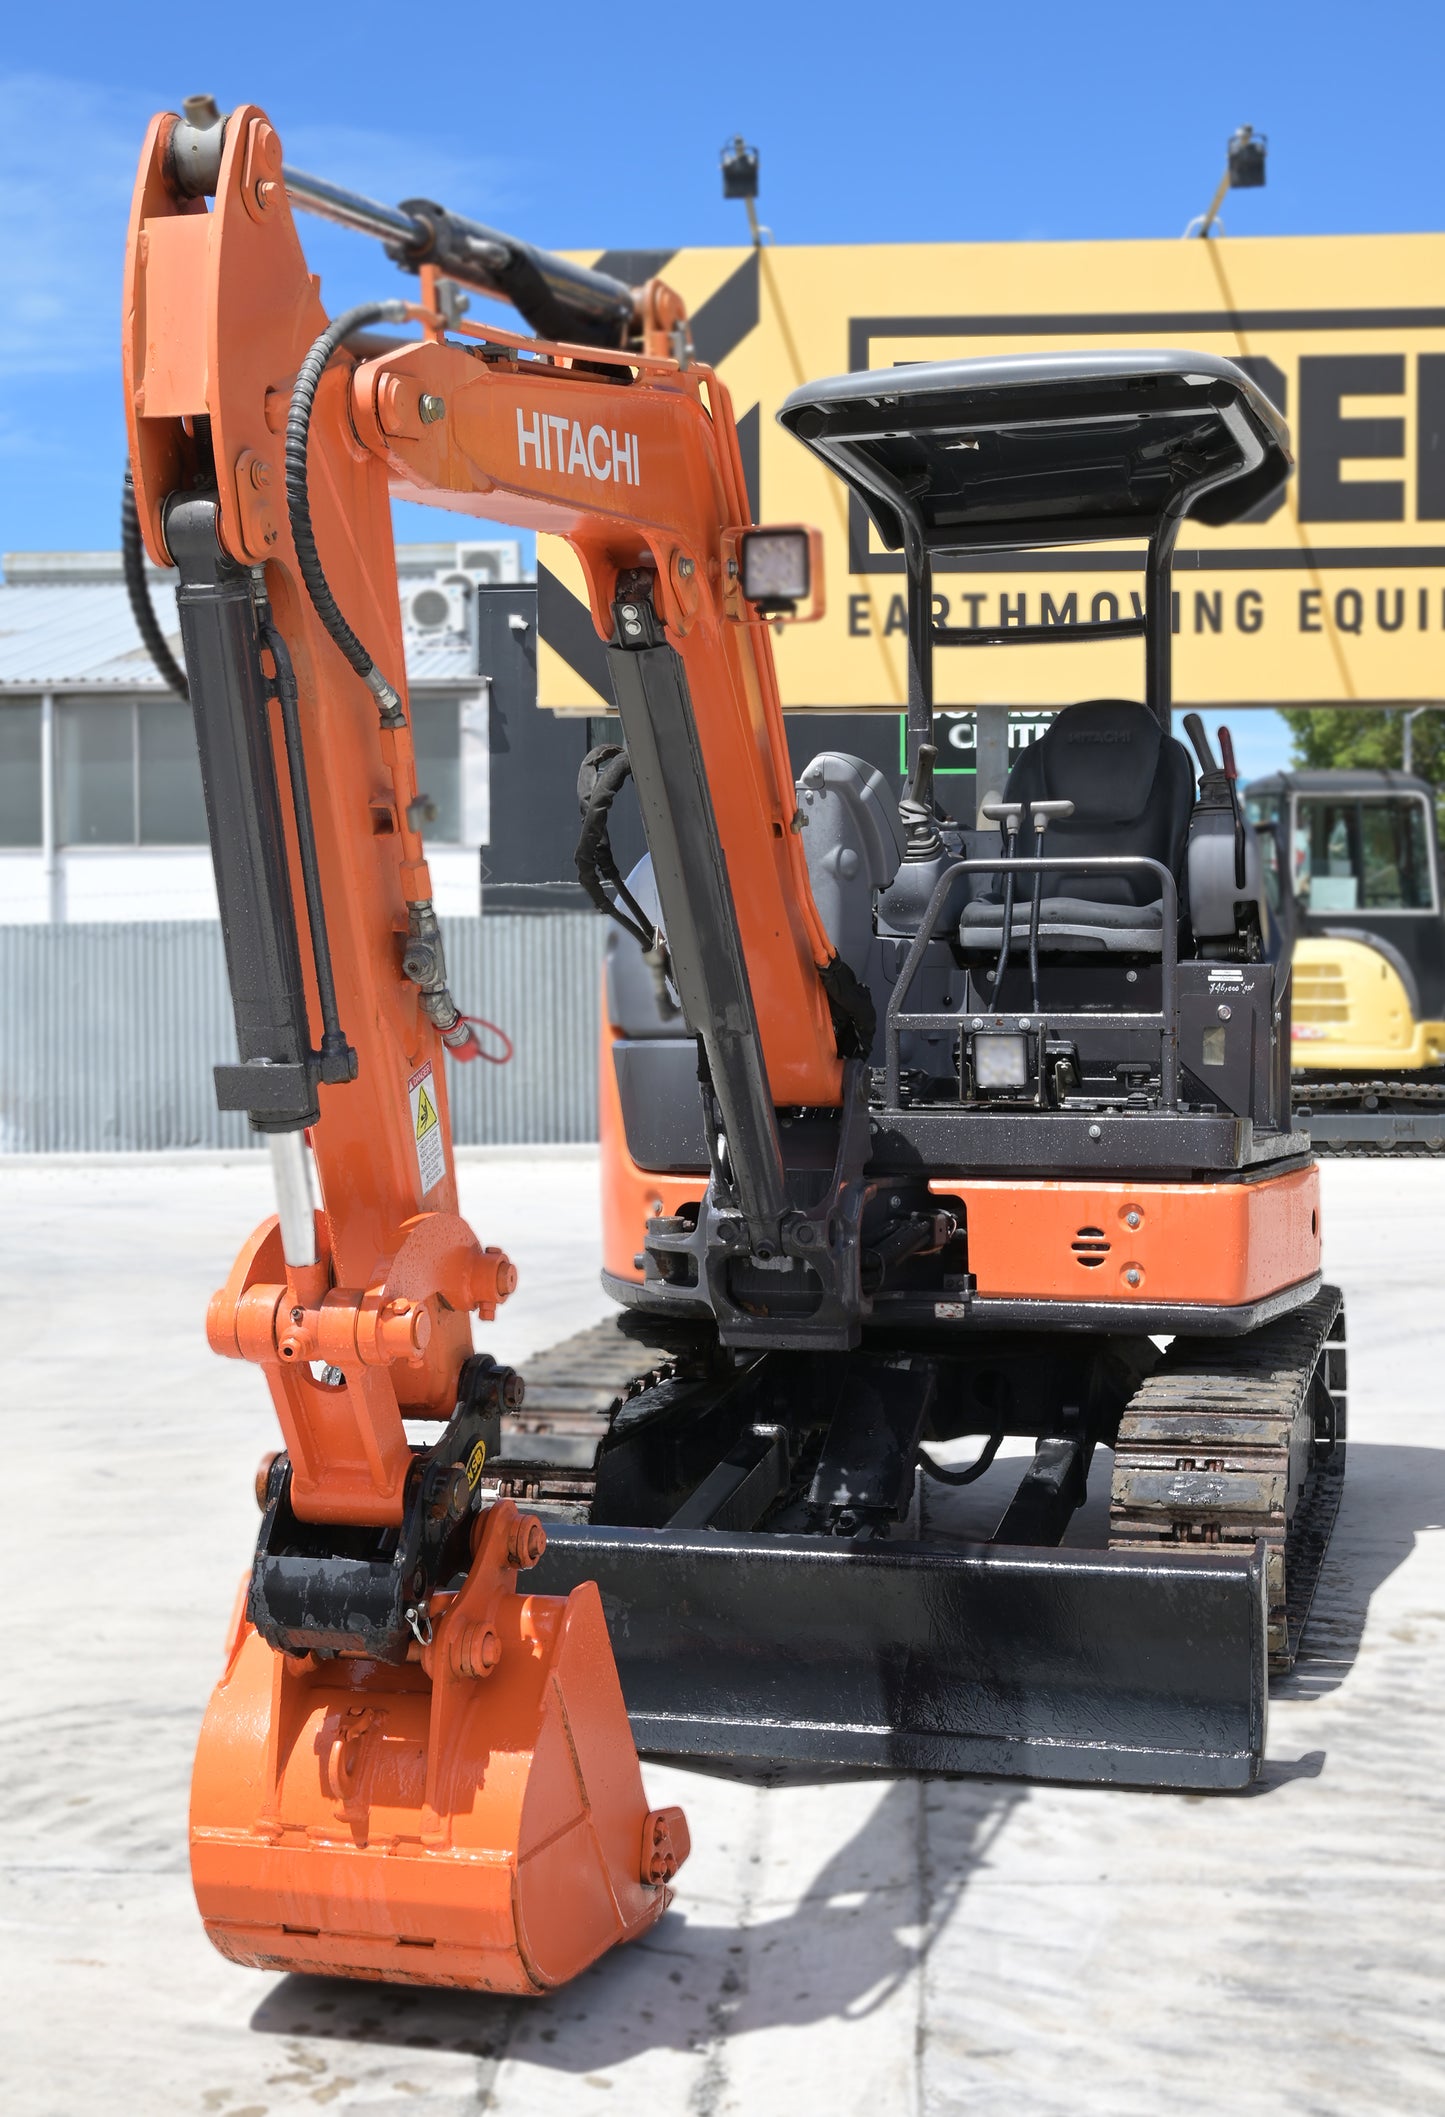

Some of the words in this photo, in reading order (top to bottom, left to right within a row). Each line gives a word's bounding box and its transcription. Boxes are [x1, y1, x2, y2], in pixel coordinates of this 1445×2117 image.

[516, 407, 640, 486] HITACHI
[1299, 588, 1445, 636] EQUI
[1067, 729, 1132, 743] HITACHI
[412, 1064, 432, 1086] DANGER
